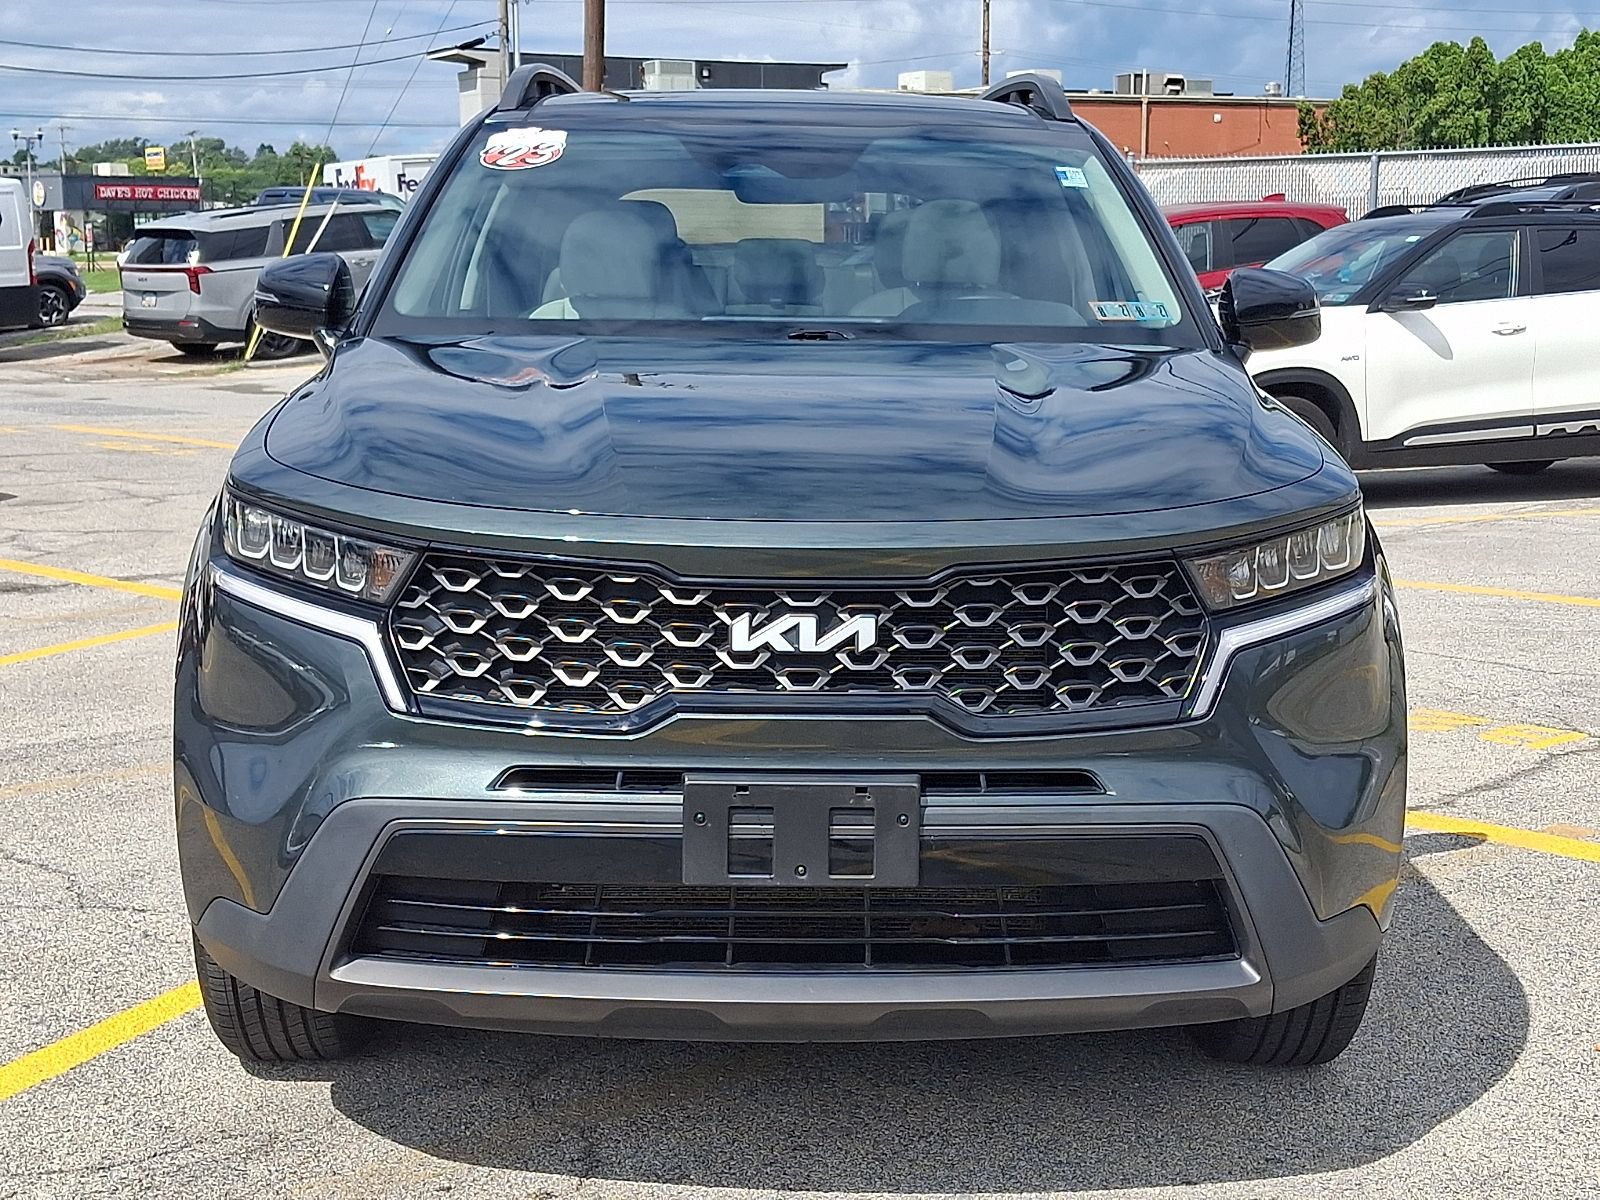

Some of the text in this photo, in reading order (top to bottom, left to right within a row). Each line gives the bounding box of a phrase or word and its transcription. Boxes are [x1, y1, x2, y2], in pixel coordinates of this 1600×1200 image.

[135, 187, 153, 198] HOT
[157, 188, 199, 199] CHICKEN
[397, 173, 421, 193] Fe
[730, 612, 877, 655] KIA
